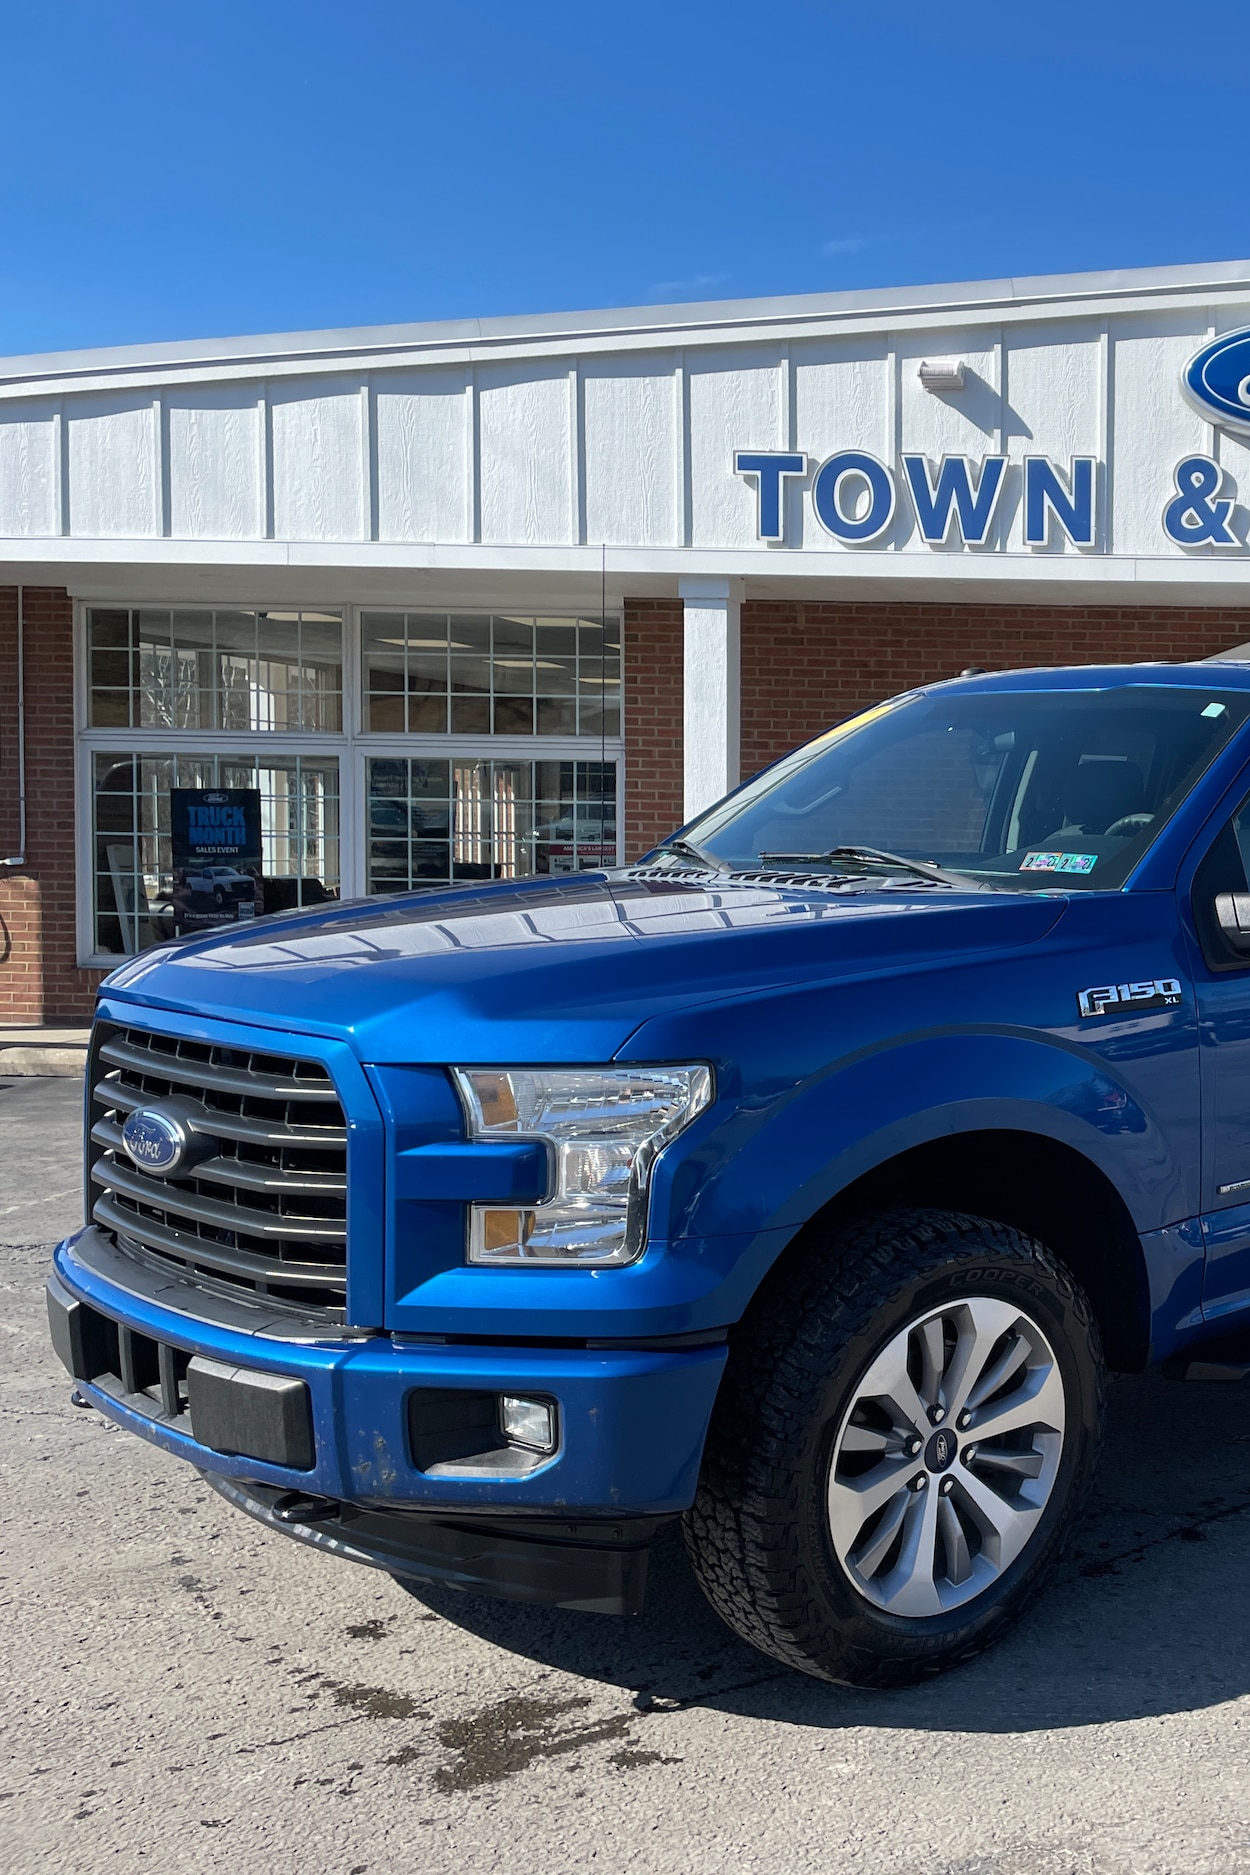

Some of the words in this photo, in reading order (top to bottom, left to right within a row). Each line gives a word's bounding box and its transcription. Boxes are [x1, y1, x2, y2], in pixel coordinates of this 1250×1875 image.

[734, 450, 1097, 547] TOWN
[1162, 454, 1236, 548] &
[187, 806, 246, 826] TRUCK
[188, 827, 246, 845] MONTH
[1164, 996, 1180, 1005] XL
[948, 1268, 1044, 1297] COOPER
